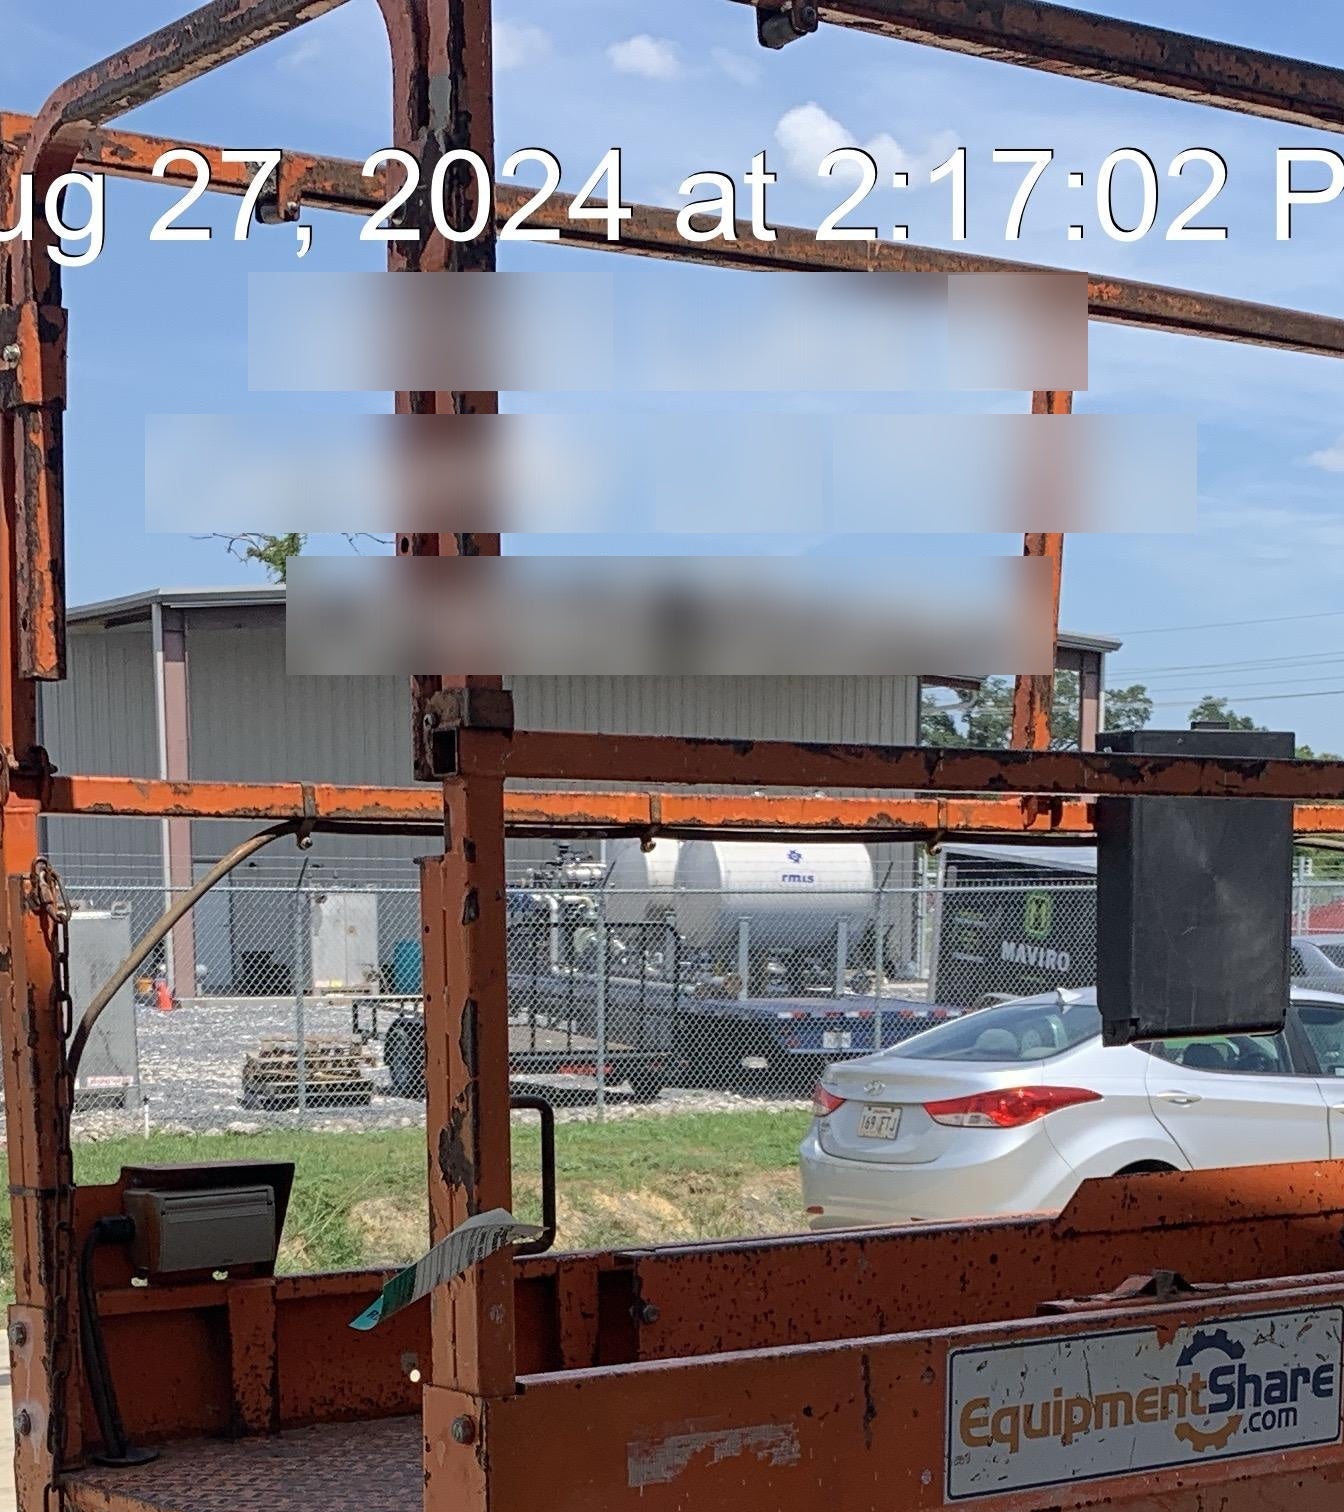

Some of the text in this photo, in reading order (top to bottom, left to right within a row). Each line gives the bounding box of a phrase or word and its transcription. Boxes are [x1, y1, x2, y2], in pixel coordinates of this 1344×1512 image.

[1001, 940, 1070, 972] MAVIRO
[959, 1362, 1335, 1454] EquipmentShare
[1243, 1406, 1299, 1435] .com
